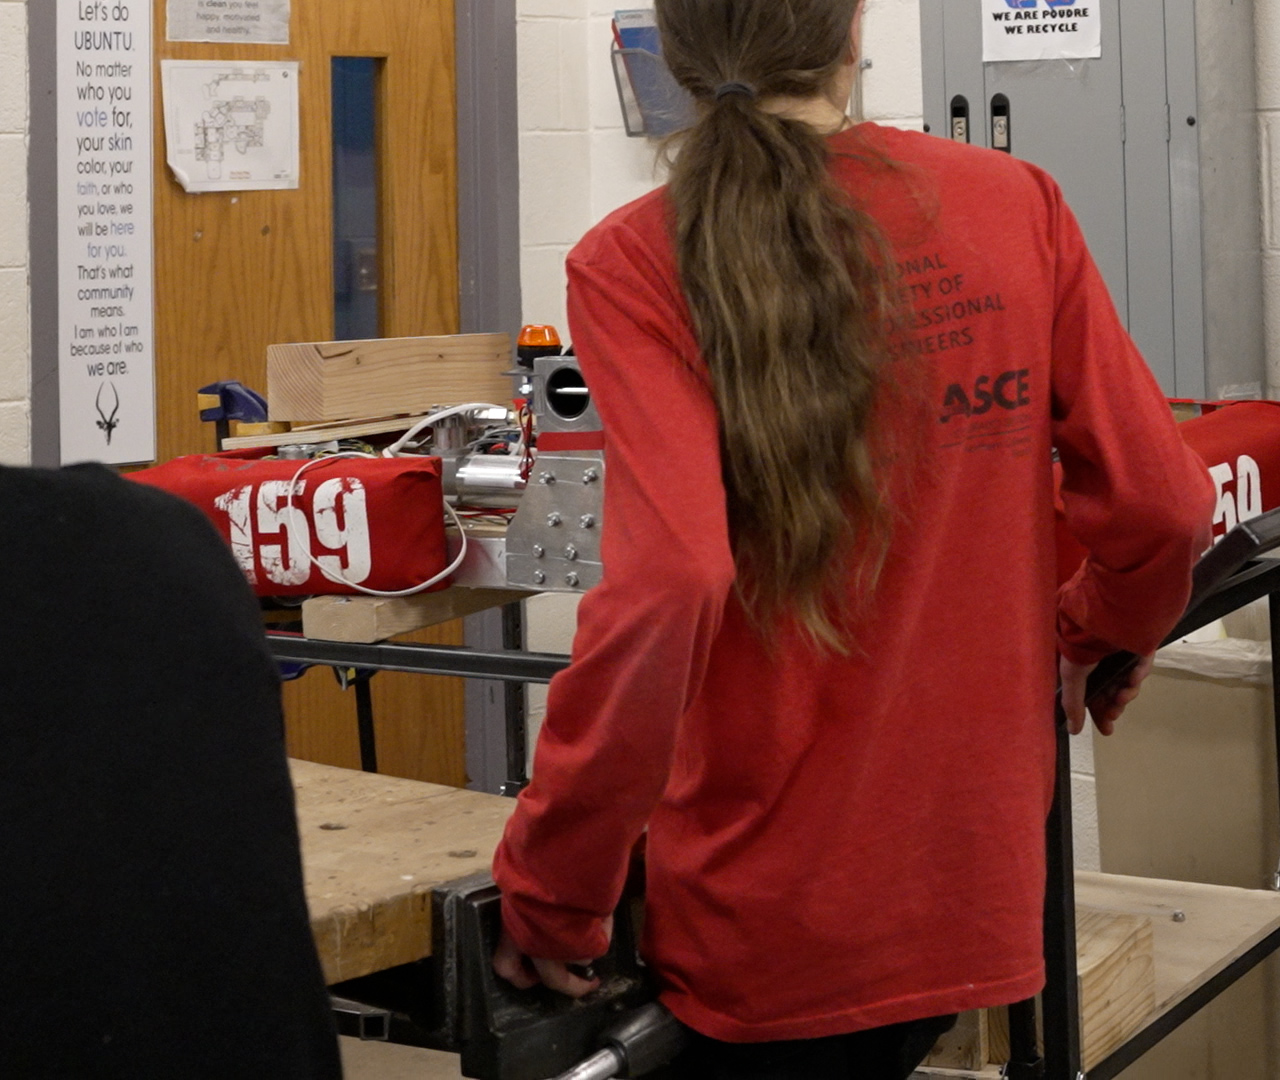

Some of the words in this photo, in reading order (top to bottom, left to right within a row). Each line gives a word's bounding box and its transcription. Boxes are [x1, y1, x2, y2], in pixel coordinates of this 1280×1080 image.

[79, 0, 108, 21] Let's
[112, 0, 129, 21] do
[992, 11, 1011, 21] WE
[1014, 10, 1038, 20] ARE
[1042, 8, 1089, 19] POUDRE
[1005, 25, 1023, 35] WE
[1027, 23, 1078, 33] RECYCLE
[75, 31, 135, 51] UBUNTU.
[76, 61, 92, 77] No
[95, 61, 132, 77] matter
[77, 83, 104, 101] who
[108, 86, 131, 105] you
[77, 109, 108, 128] vote
[112, 107, 133, 129] for,
[77, 136, 105, 156] your
[108, 133, 132, 151] skin
[76, 159, 107, 176] color,
[109, 159, 133, 177] your
[77, 181, 99, 197] faith,
[101, 184, 111, 195] or
[114, 181, 133, 195] who
[78, 204, 94, 217] you
[120, 203, 133, 214] we
[78, 222, 93, 236] will
[95, 222, 108, 236] be
[110, 220, 134, 235] here
[87, 244, 101, 258] for
[105, 246, 127, 261] you.
[78, 265, 106, 280] That's
[109, 264, 133, 279] what
[939, 273, 964, 295] OF
[78, 285, 134, 302] community
[91, 307, 125, 318] means.
[79, 329, 94, 339] am
[97, 325, 117, 338] who
[124, 326, 138, 336] am
[71, 343, 110, 357] because
[112, 341, 122, 354] of
[125, 341, 143, 353] who
[87, 363, 104, 377] we
[106, 361, 129, 376] are.
[941, 368, 1030, 418] ASCE
[214, 477, 373, 587] 159
